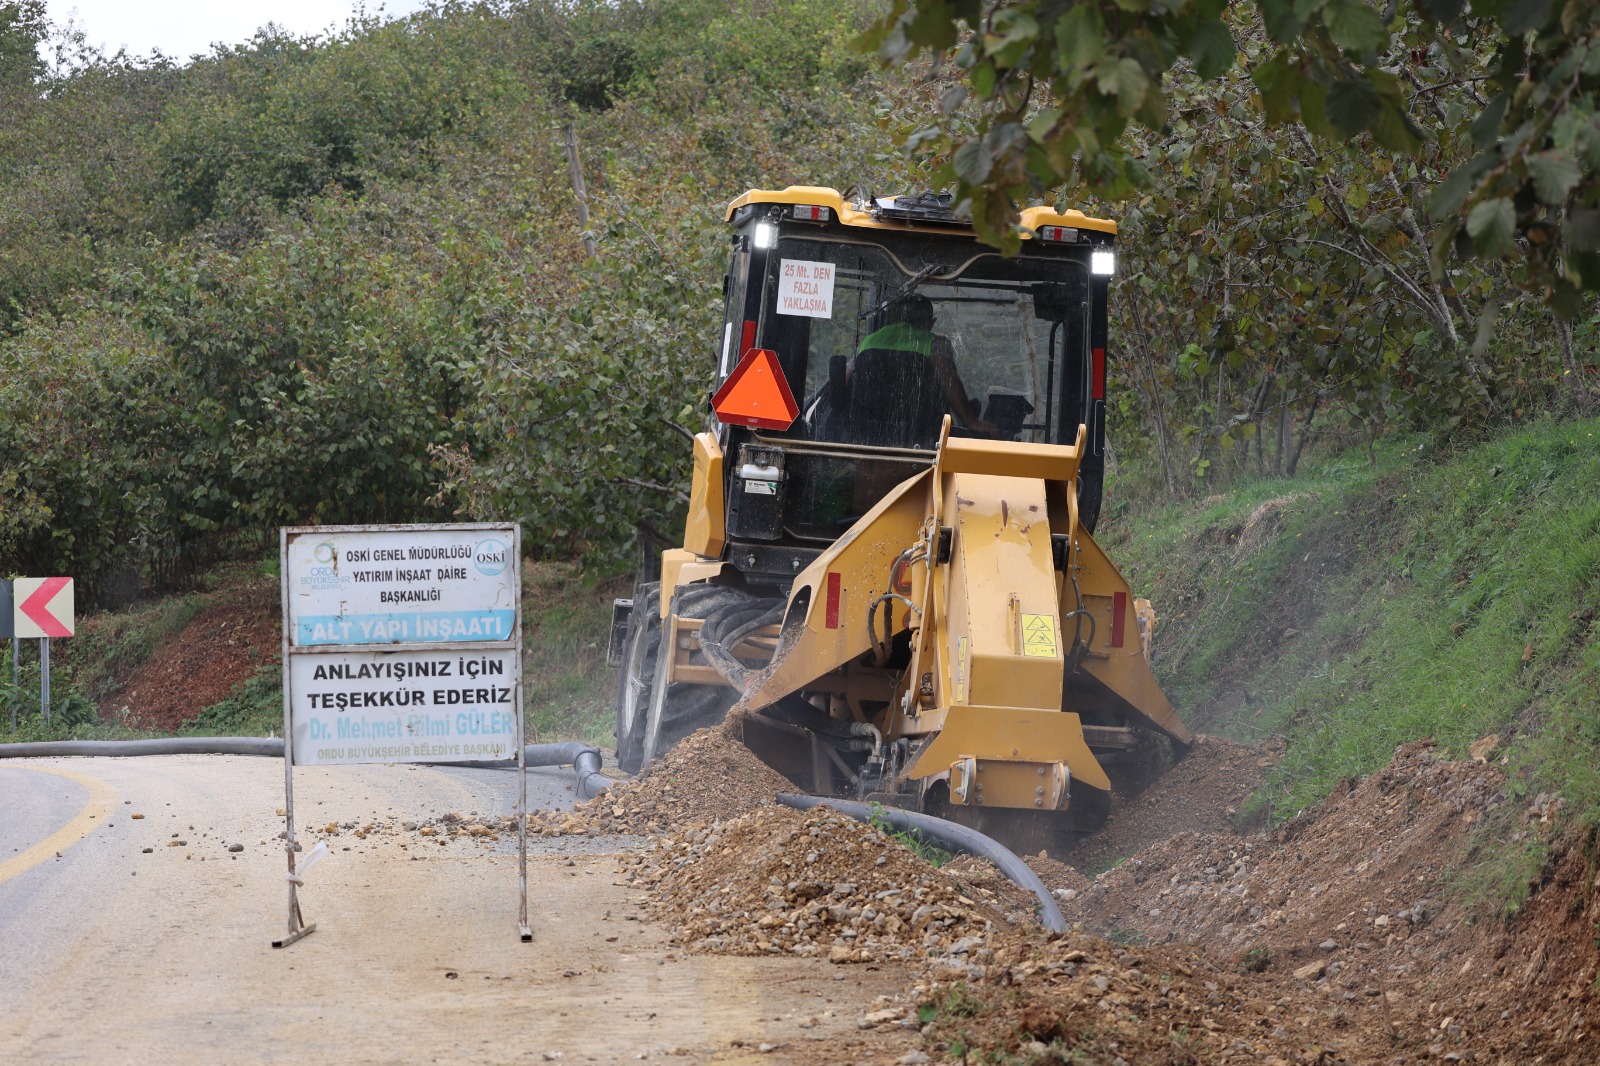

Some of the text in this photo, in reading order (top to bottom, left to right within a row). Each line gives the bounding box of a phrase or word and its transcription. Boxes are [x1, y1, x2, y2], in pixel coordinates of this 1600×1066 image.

[785, 264, 831, 280] 25 Mt. DEN
[793, 281, 819, 295] FAZLA
[783, 296, 827, 314] YAKLAŞMA
[346, 545, 472, 562] OSKİ GENEL MÜDÜRLÜĞÜ
[476, 551, 505, 563] OSKİ
[352, 571, 393, 583] YATIRIM
[396, 569, 431, 584] İNŞAAT
[380, 587, 441, 605] BAŞKANLIĞI
[311, 615, 502, 641] ALT YAPI İNŞAATI
[313, 656, 503, 682] ANLAYIŞINIZ İÇİN
[307, 684, 512, 712] TEŞEKKÜR EDERİZ
[309, 716, 332, 740] Dr.
[456, 708, 513, 736] GÜLER
[317, 748, 345, 760] ORDU
